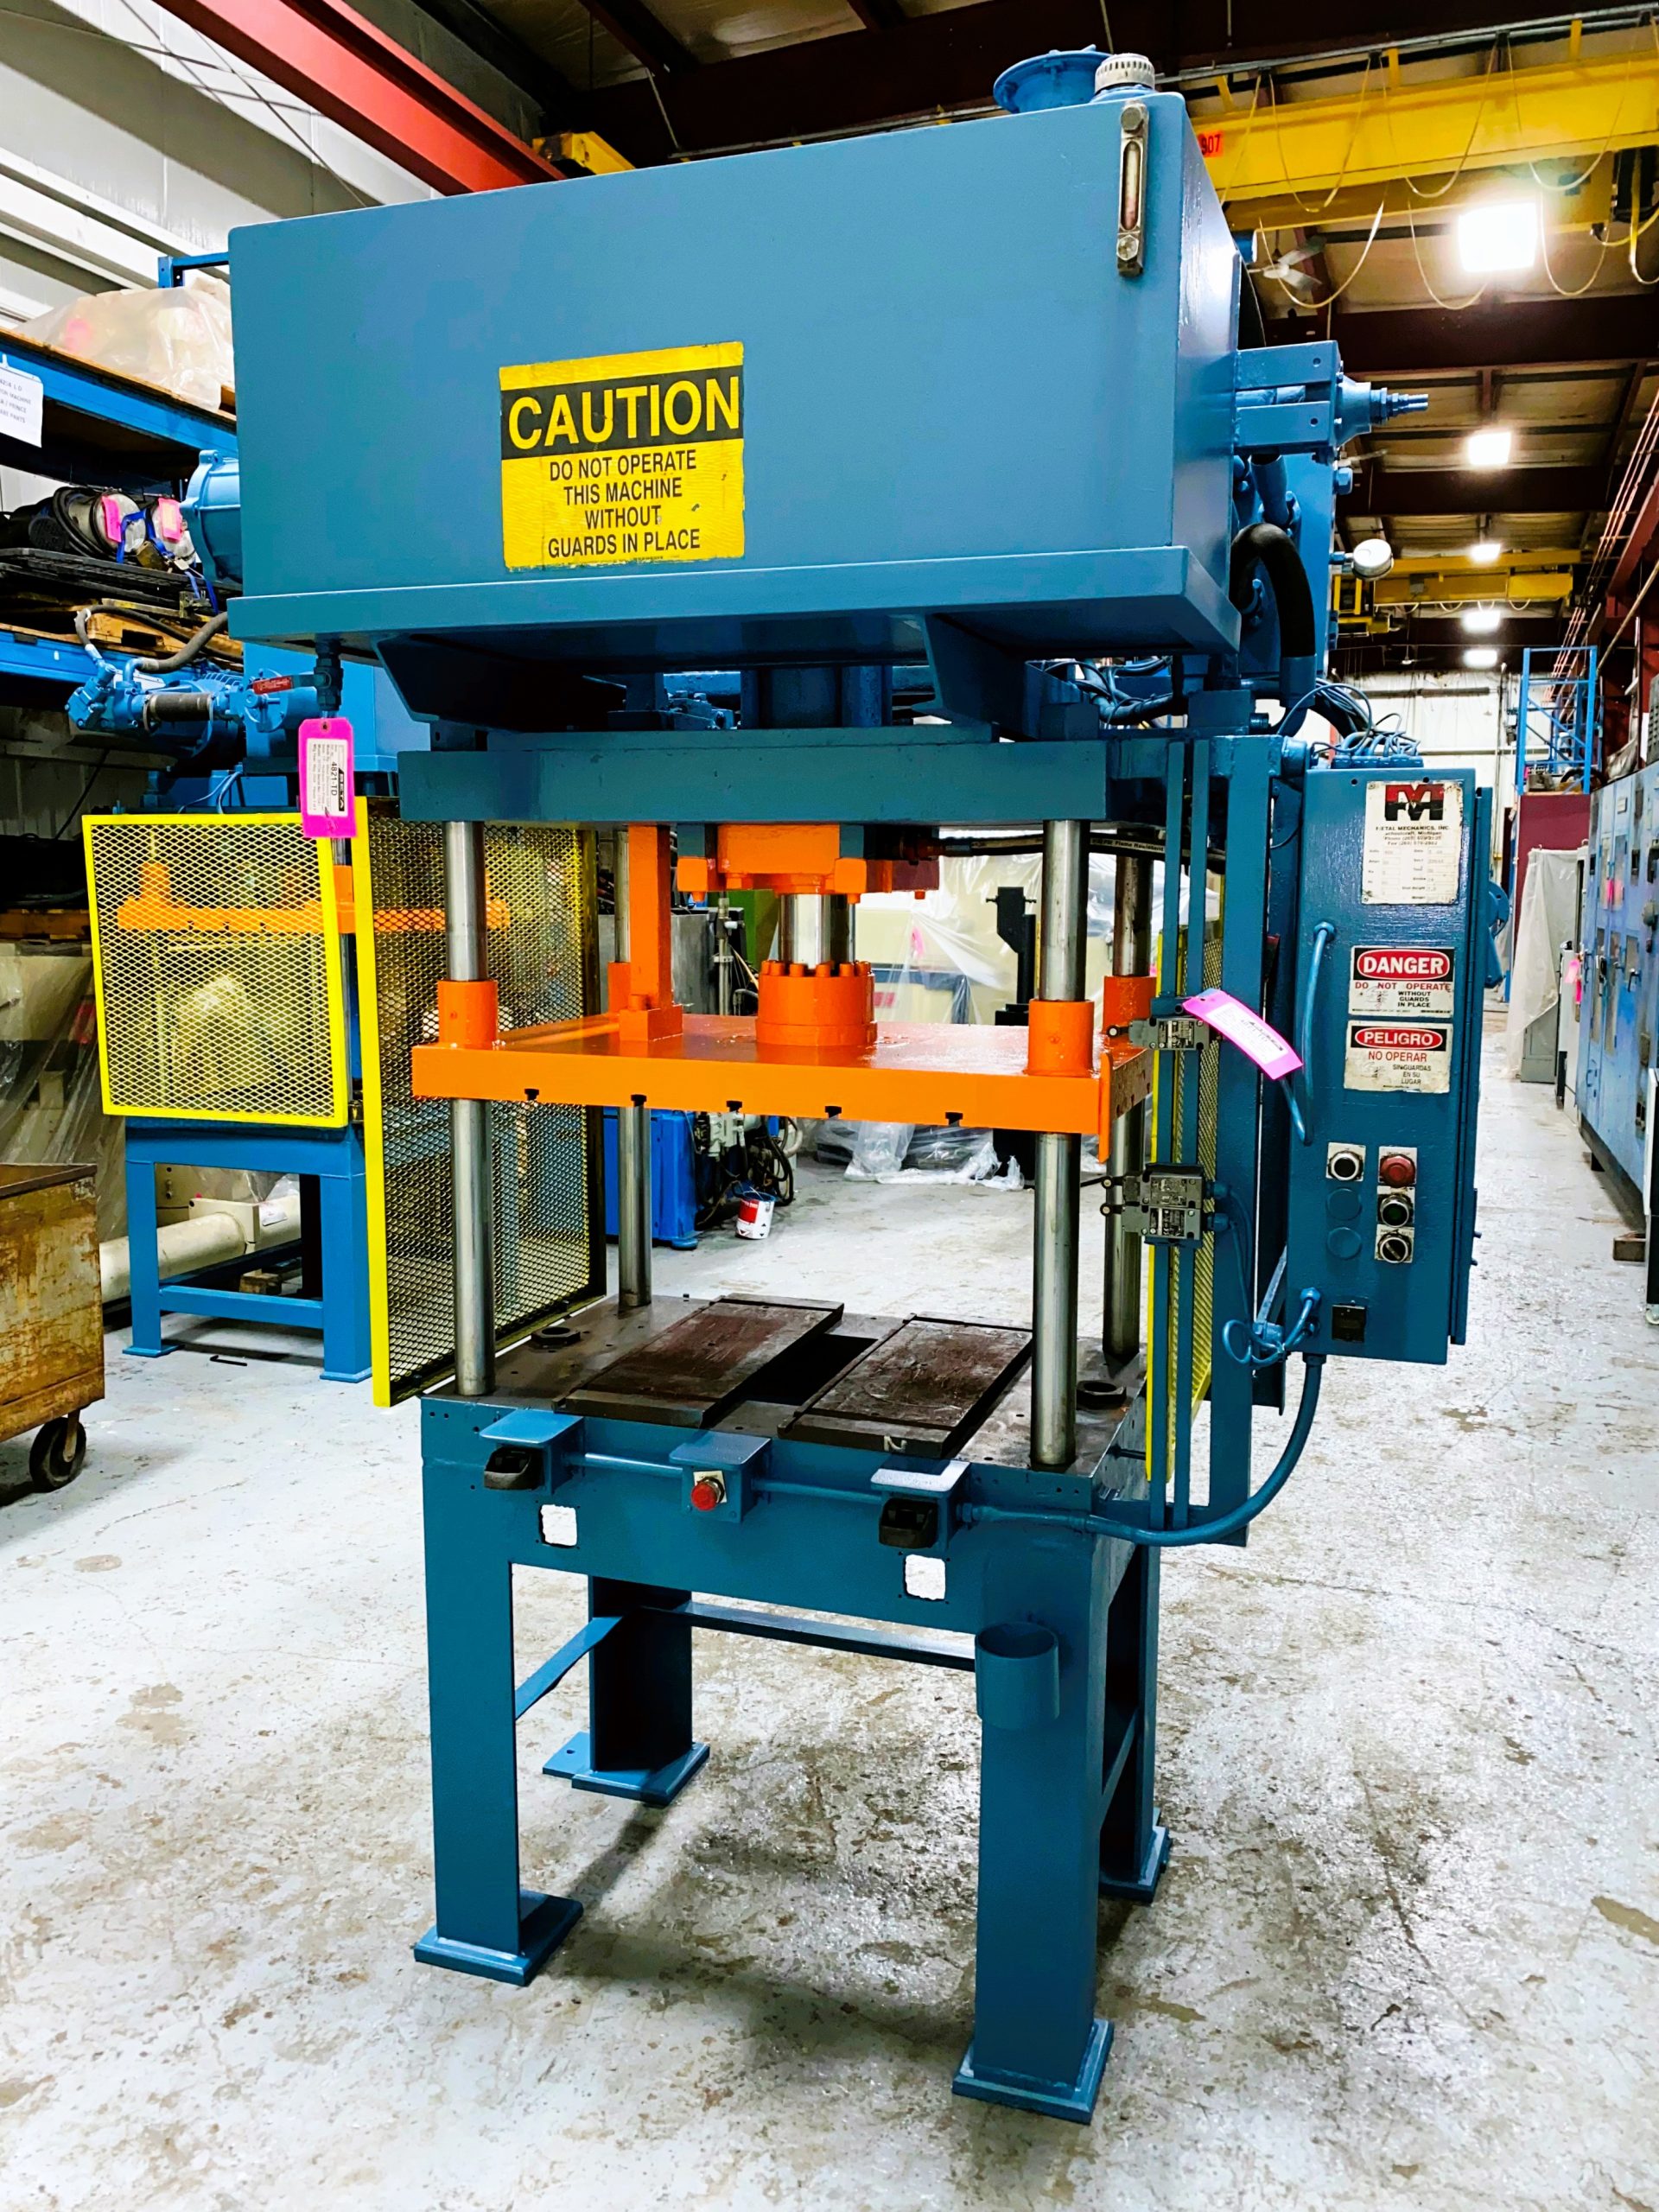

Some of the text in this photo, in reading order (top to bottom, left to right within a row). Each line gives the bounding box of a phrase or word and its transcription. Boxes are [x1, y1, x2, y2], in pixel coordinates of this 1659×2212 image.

[508, 376, 740, 449] CAUTION
[550, 449, 697, 481] DO NOT OPERATE
[563, 477, 683, 505] THIS MACHINE
[585, 505, 662, 530] WITHOUT
[548, 529, 701, 558] GUARDS IN PLACE
[1363, 957, 1444, 975] DANGER
[1377, 982, 1397, 990] NOT
[1406, 982, 1451, 991] OPERATE
[1363, 1031, 1433, 1046] PELIGRO
[1368, 1051, 1427, 1063] NO OPERAR
